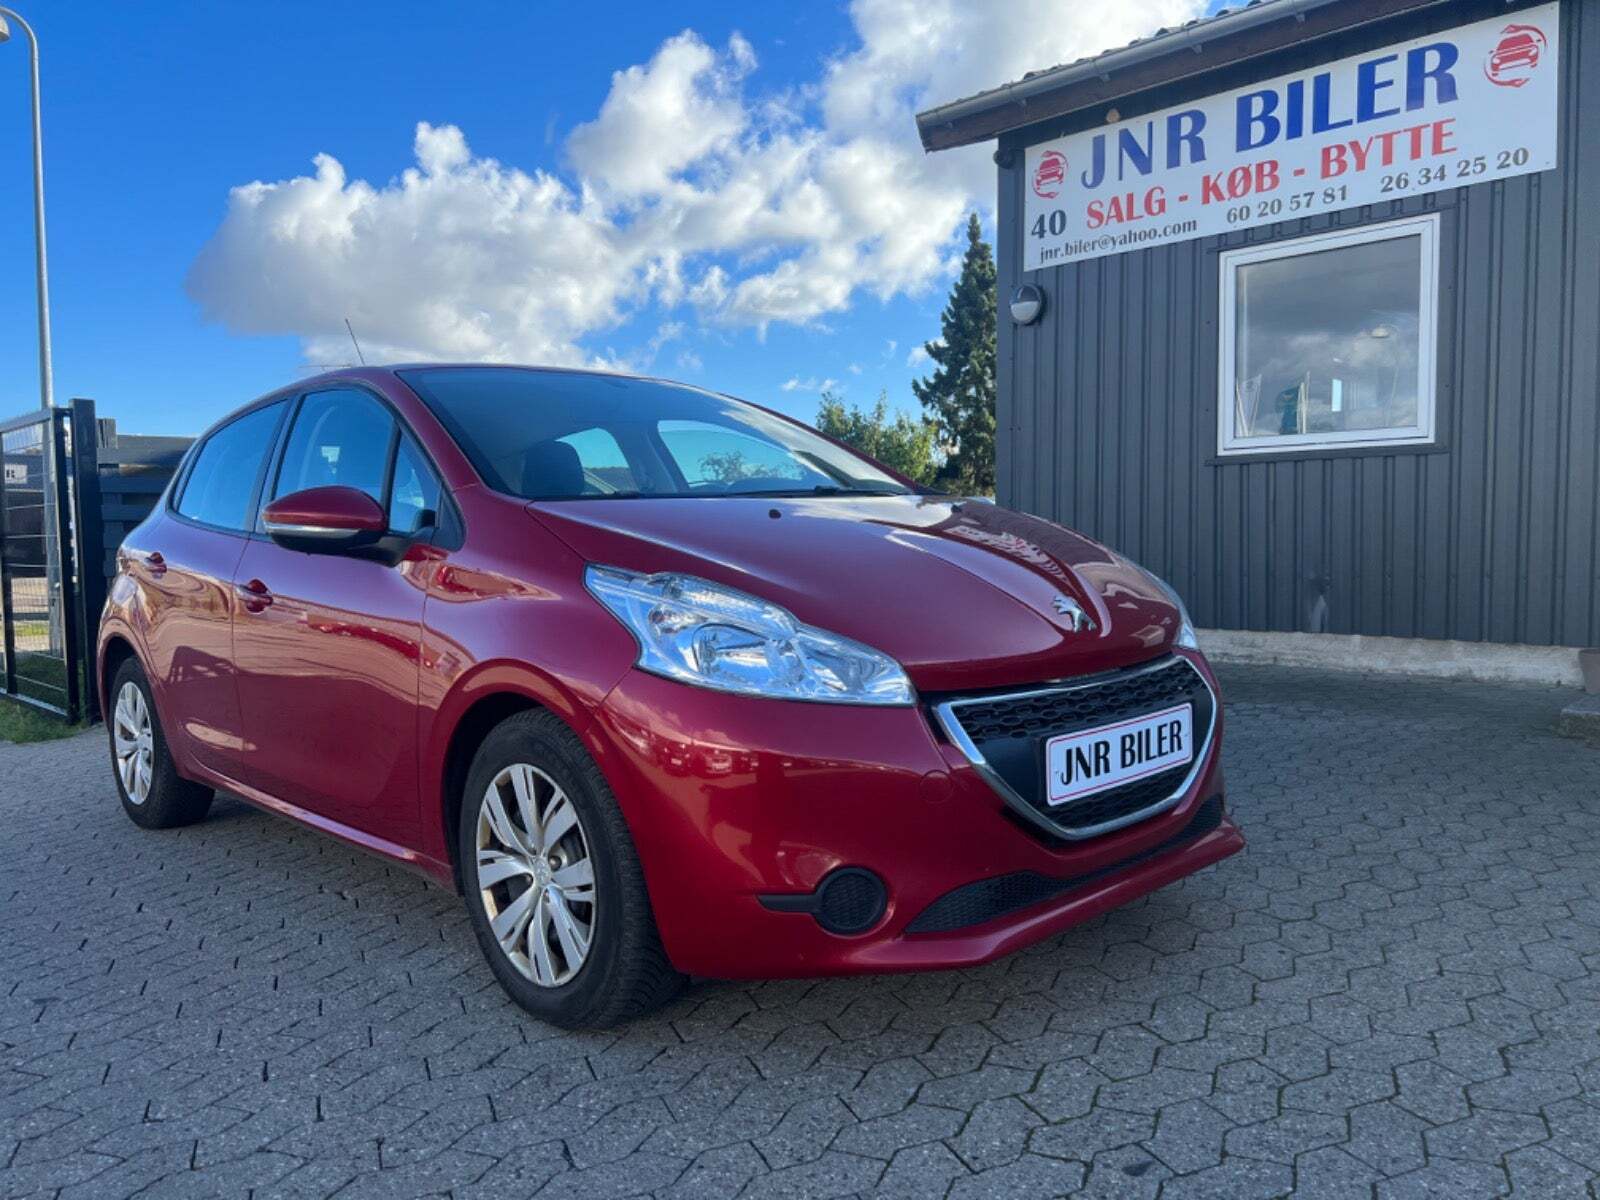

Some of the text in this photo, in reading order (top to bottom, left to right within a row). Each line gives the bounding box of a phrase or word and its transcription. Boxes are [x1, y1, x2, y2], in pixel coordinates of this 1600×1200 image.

[1081, 42, 1459, 189] JNR BILER
[1086, 186, 1167, 229] SALG
[1201, 159, 1280, 205] KØB
[1320, 118, 1457, 179] BYTTE
[1380, 147, 1530, 193] 26 34 25 20
[1031, 209, 1066, 239] 40
[1226, 184, 1347, 224] 60 20 57 81
[1040, 220, 1197, 264] jnr.biler@yahoo.com
[1060, 720, 1183, 785] JNR BILER
